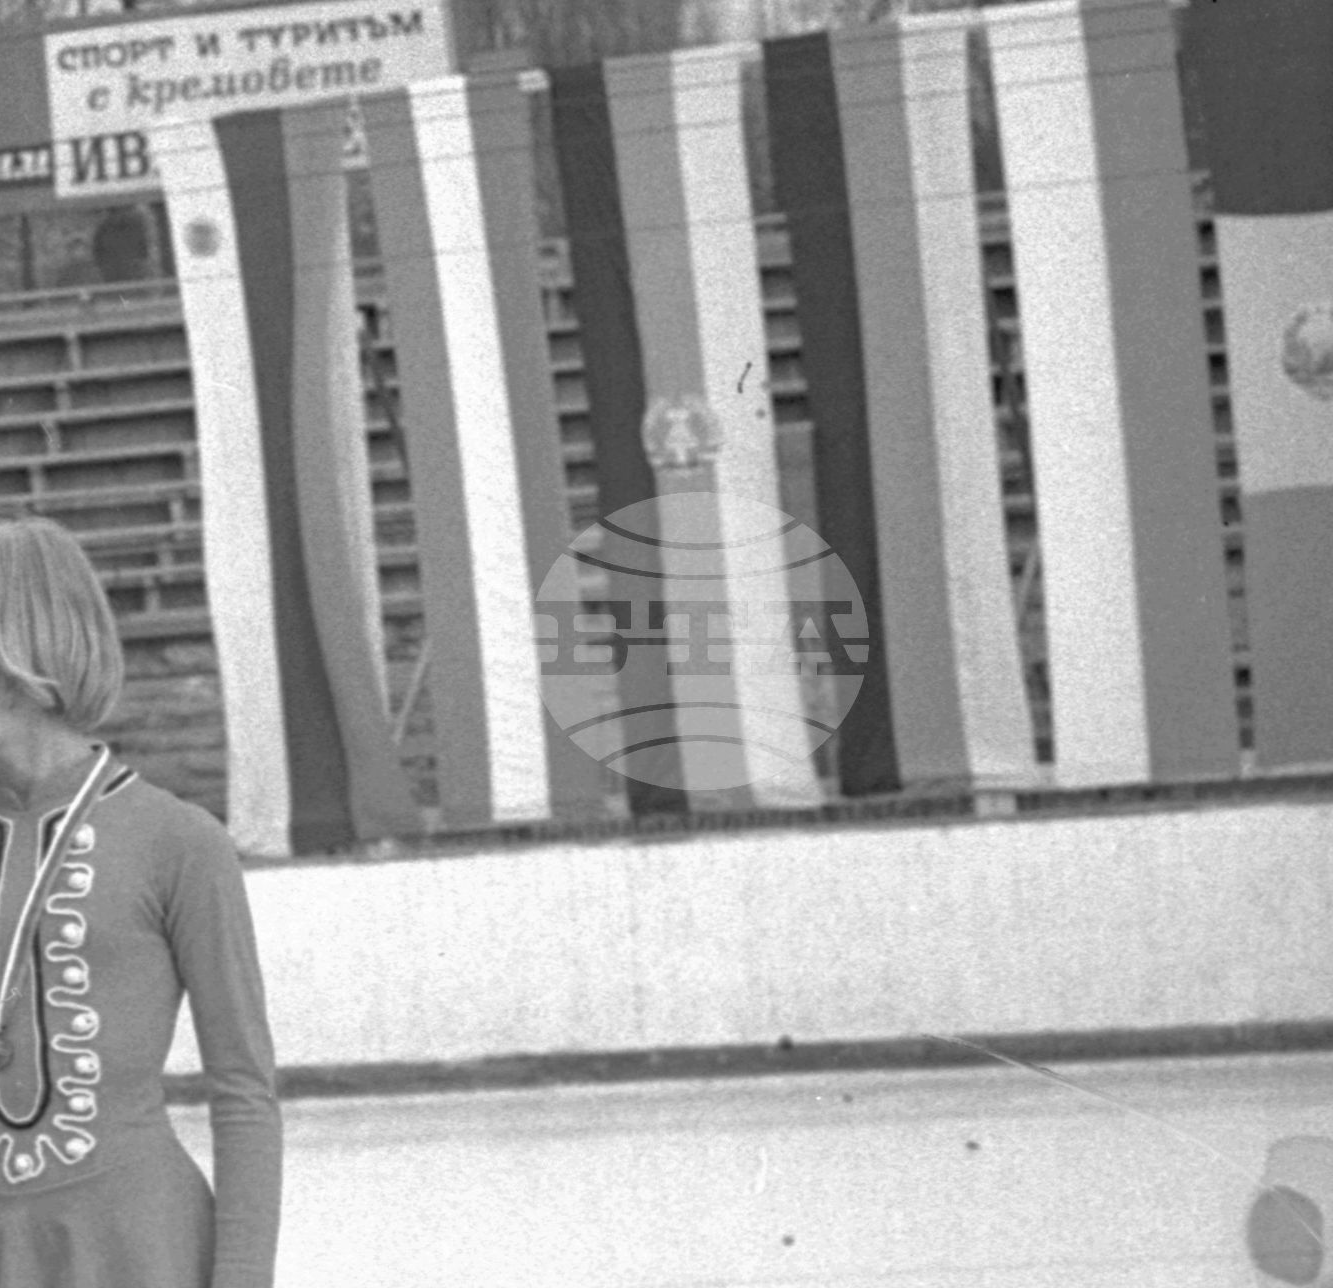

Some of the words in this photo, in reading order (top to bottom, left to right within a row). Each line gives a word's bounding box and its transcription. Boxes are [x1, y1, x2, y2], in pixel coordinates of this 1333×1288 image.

[56, 35, 175, 72] СПОРТ
[194, 31, 221, 58] И
[86, 85, 110, 111] с
[70, 129, 161, 185] ИВ
